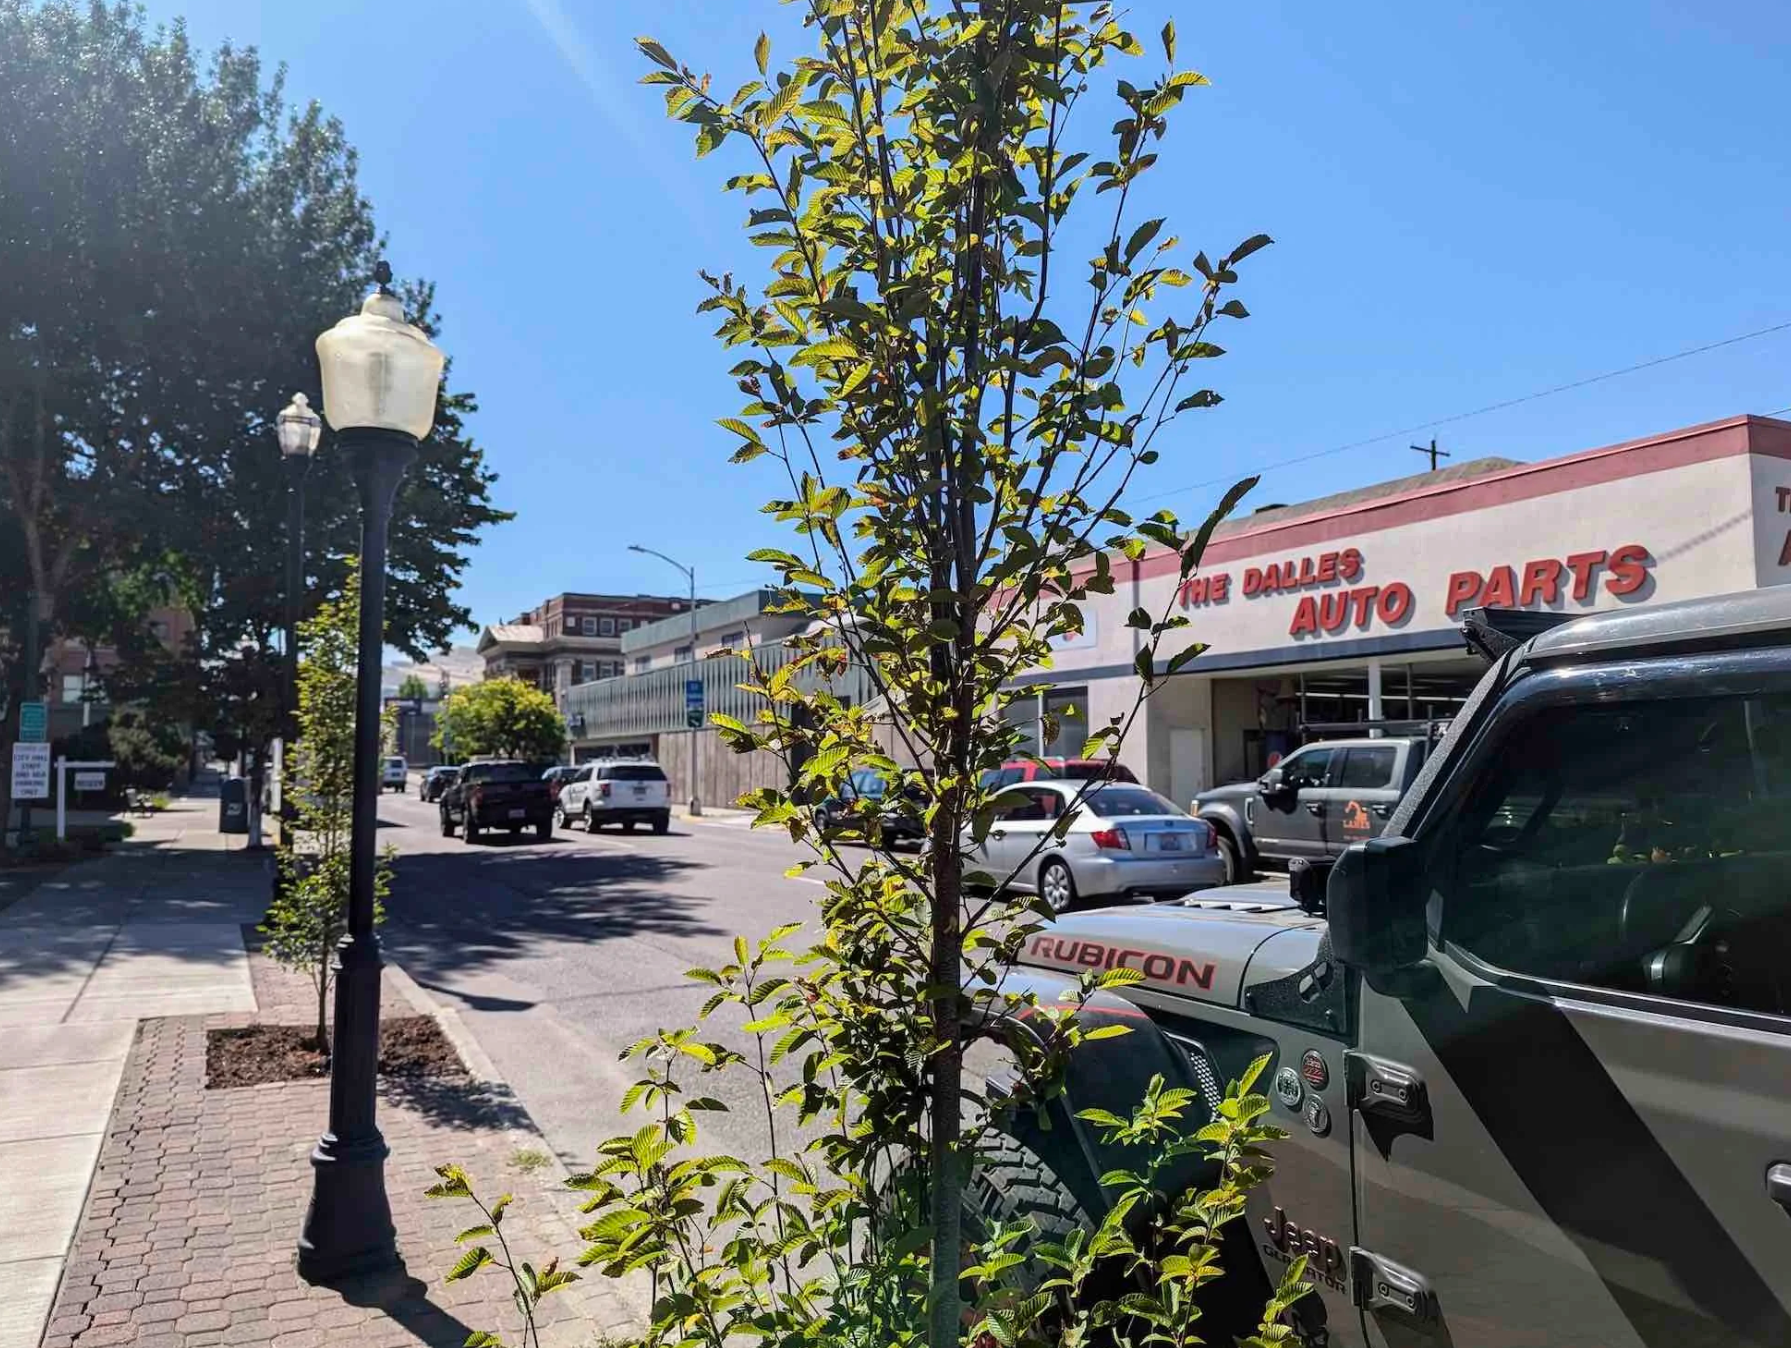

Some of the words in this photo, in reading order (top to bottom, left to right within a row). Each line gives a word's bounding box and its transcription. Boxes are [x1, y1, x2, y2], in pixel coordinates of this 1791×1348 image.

[1179, 573, 1229, 607] THE
[1243, 548, 1361, 595] DALLES
[1289, 582, 1411, 636] AUTO
[1445, 544, 1649, 616] PARTS
[1030, 935, 1216, 991] RUBICON
[1264, 1206, 1342, 1273] Jeep
[1263, 1245, 1347, 1295] GLAATOR
